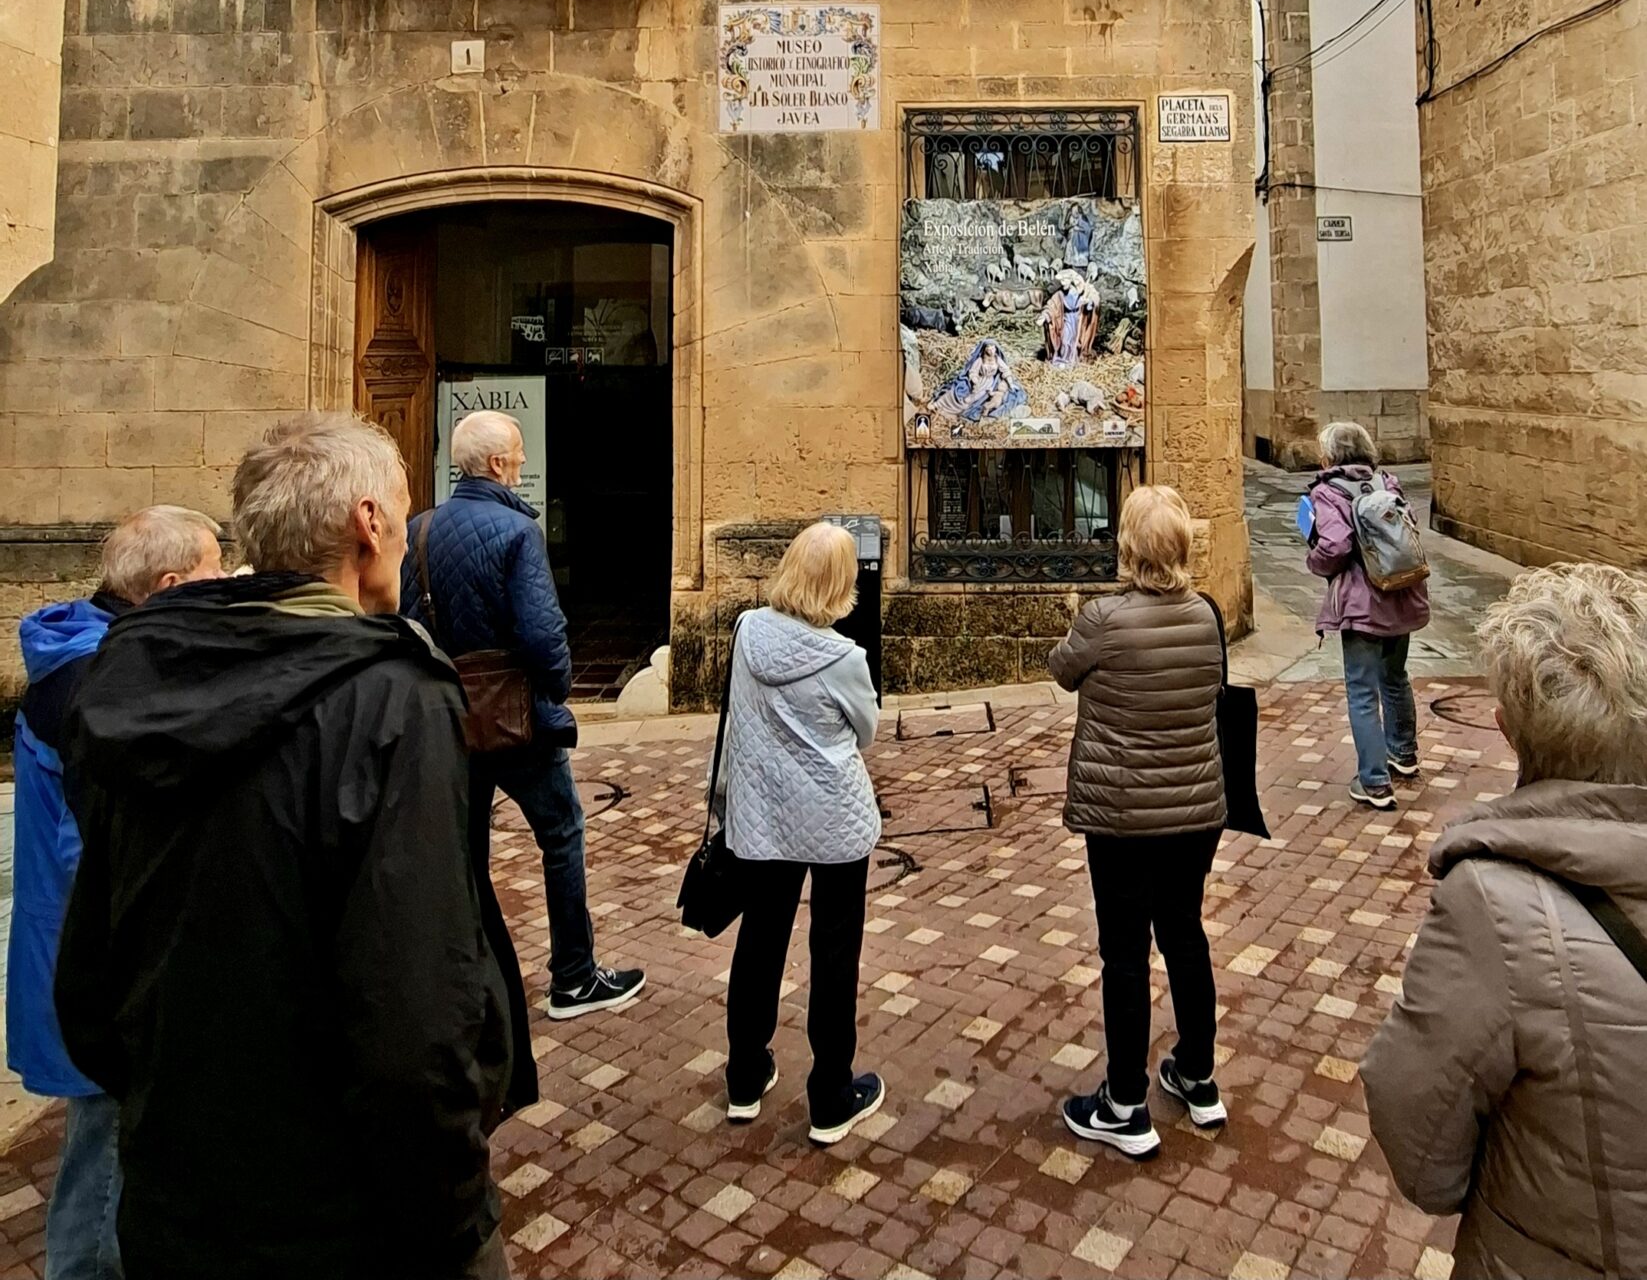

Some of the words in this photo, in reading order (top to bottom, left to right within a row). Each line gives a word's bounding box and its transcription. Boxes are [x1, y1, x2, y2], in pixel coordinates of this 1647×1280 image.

[776, 40, 822, 54] MUSEO
[466, 48, 471, 66] 1
[770, 73, 826, 87] MUNICIPAL
[772, 91, 806, 107] SOLER
[810, 90, 848, 107] BLASCO
[1161, 99, 1205, 111] PLACETA
[777, 112, 820, 124] JAVEA
[1166, 112, 1219, 125] GERMANS
[1161, 126, 1197, 137] SEGARRA
[1200, 125, 1229, 137] LLAMAS
[924, 220, 995, 240] Exposición
[998, 220, 1014, 236] de
[1018, 219, 1056, 237] Belén
[923, 243, 945, 255] Arte
[451, 385, 529, 411] XÀBIA
